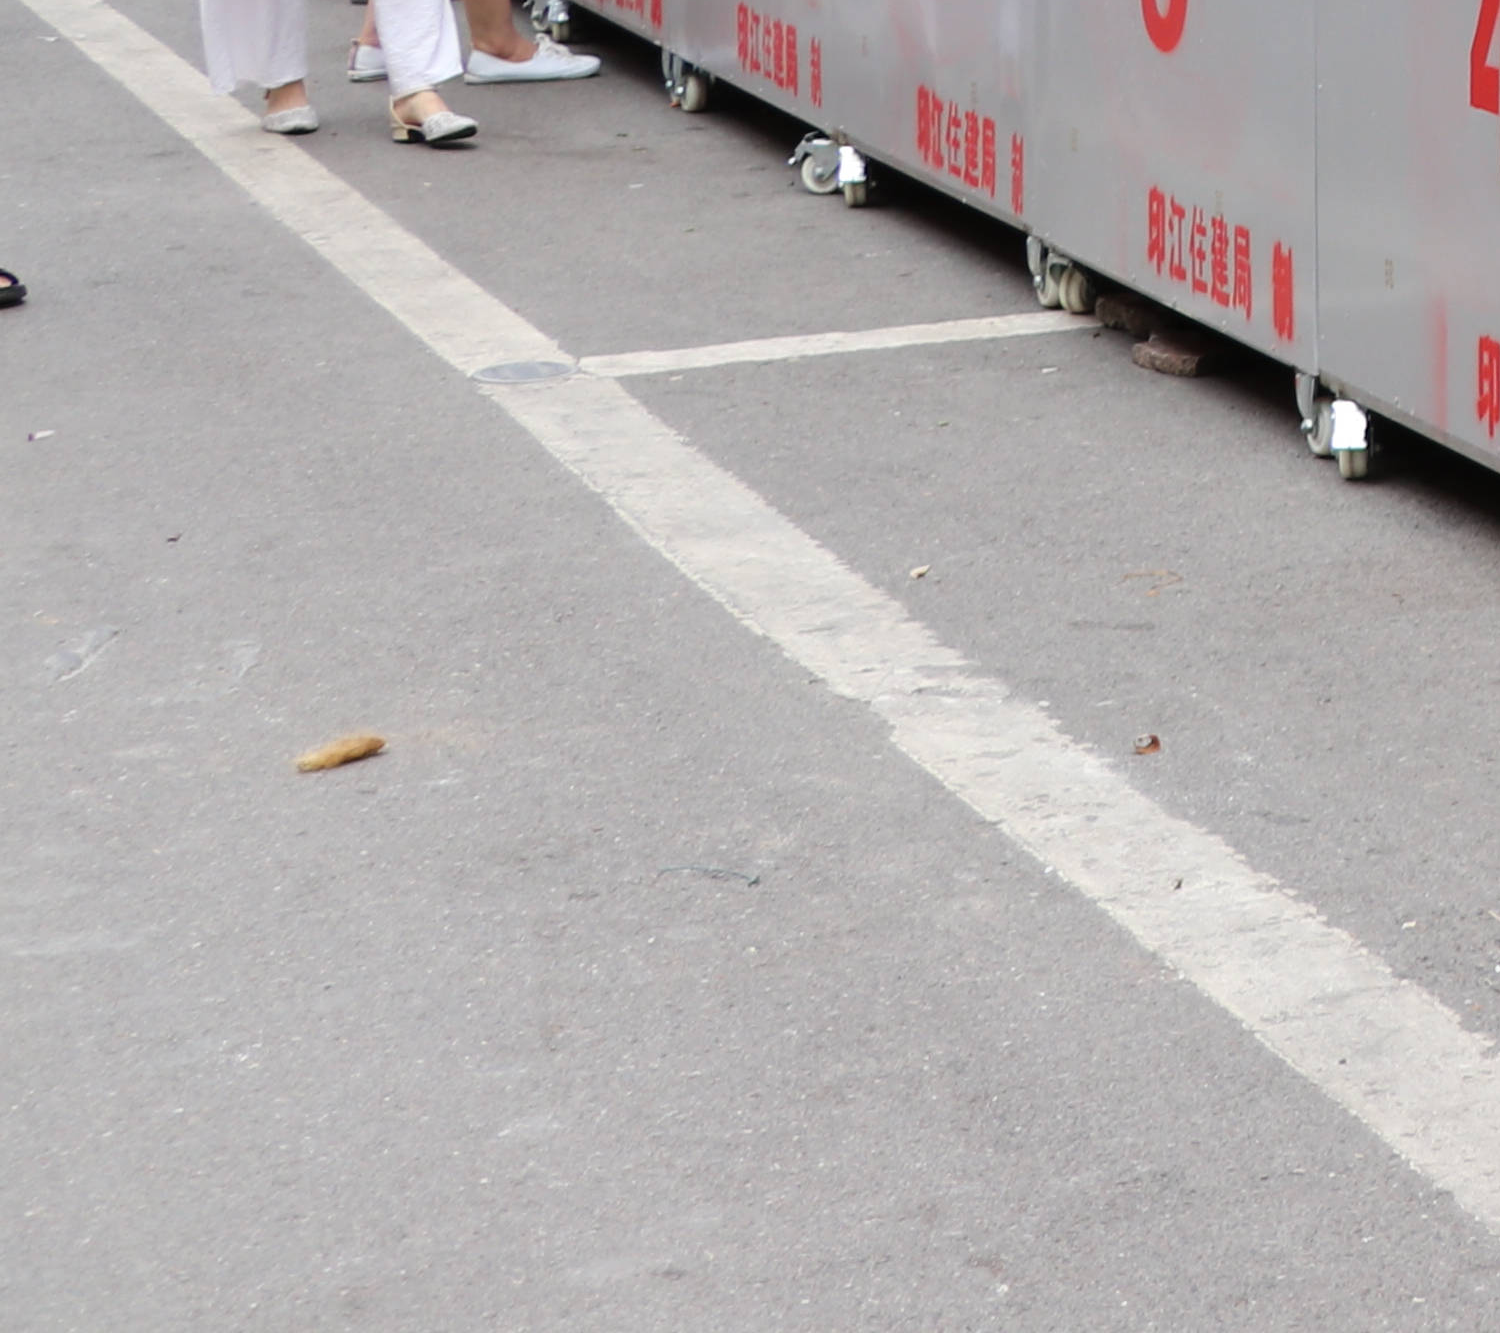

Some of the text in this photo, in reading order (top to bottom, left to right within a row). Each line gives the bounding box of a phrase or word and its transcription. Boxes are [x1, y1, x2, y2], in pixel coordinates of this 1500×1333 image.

[916, 85, 1024, 215] 印江住建局 制
[1147, 186, 1294, 342] 印江住建局 制
